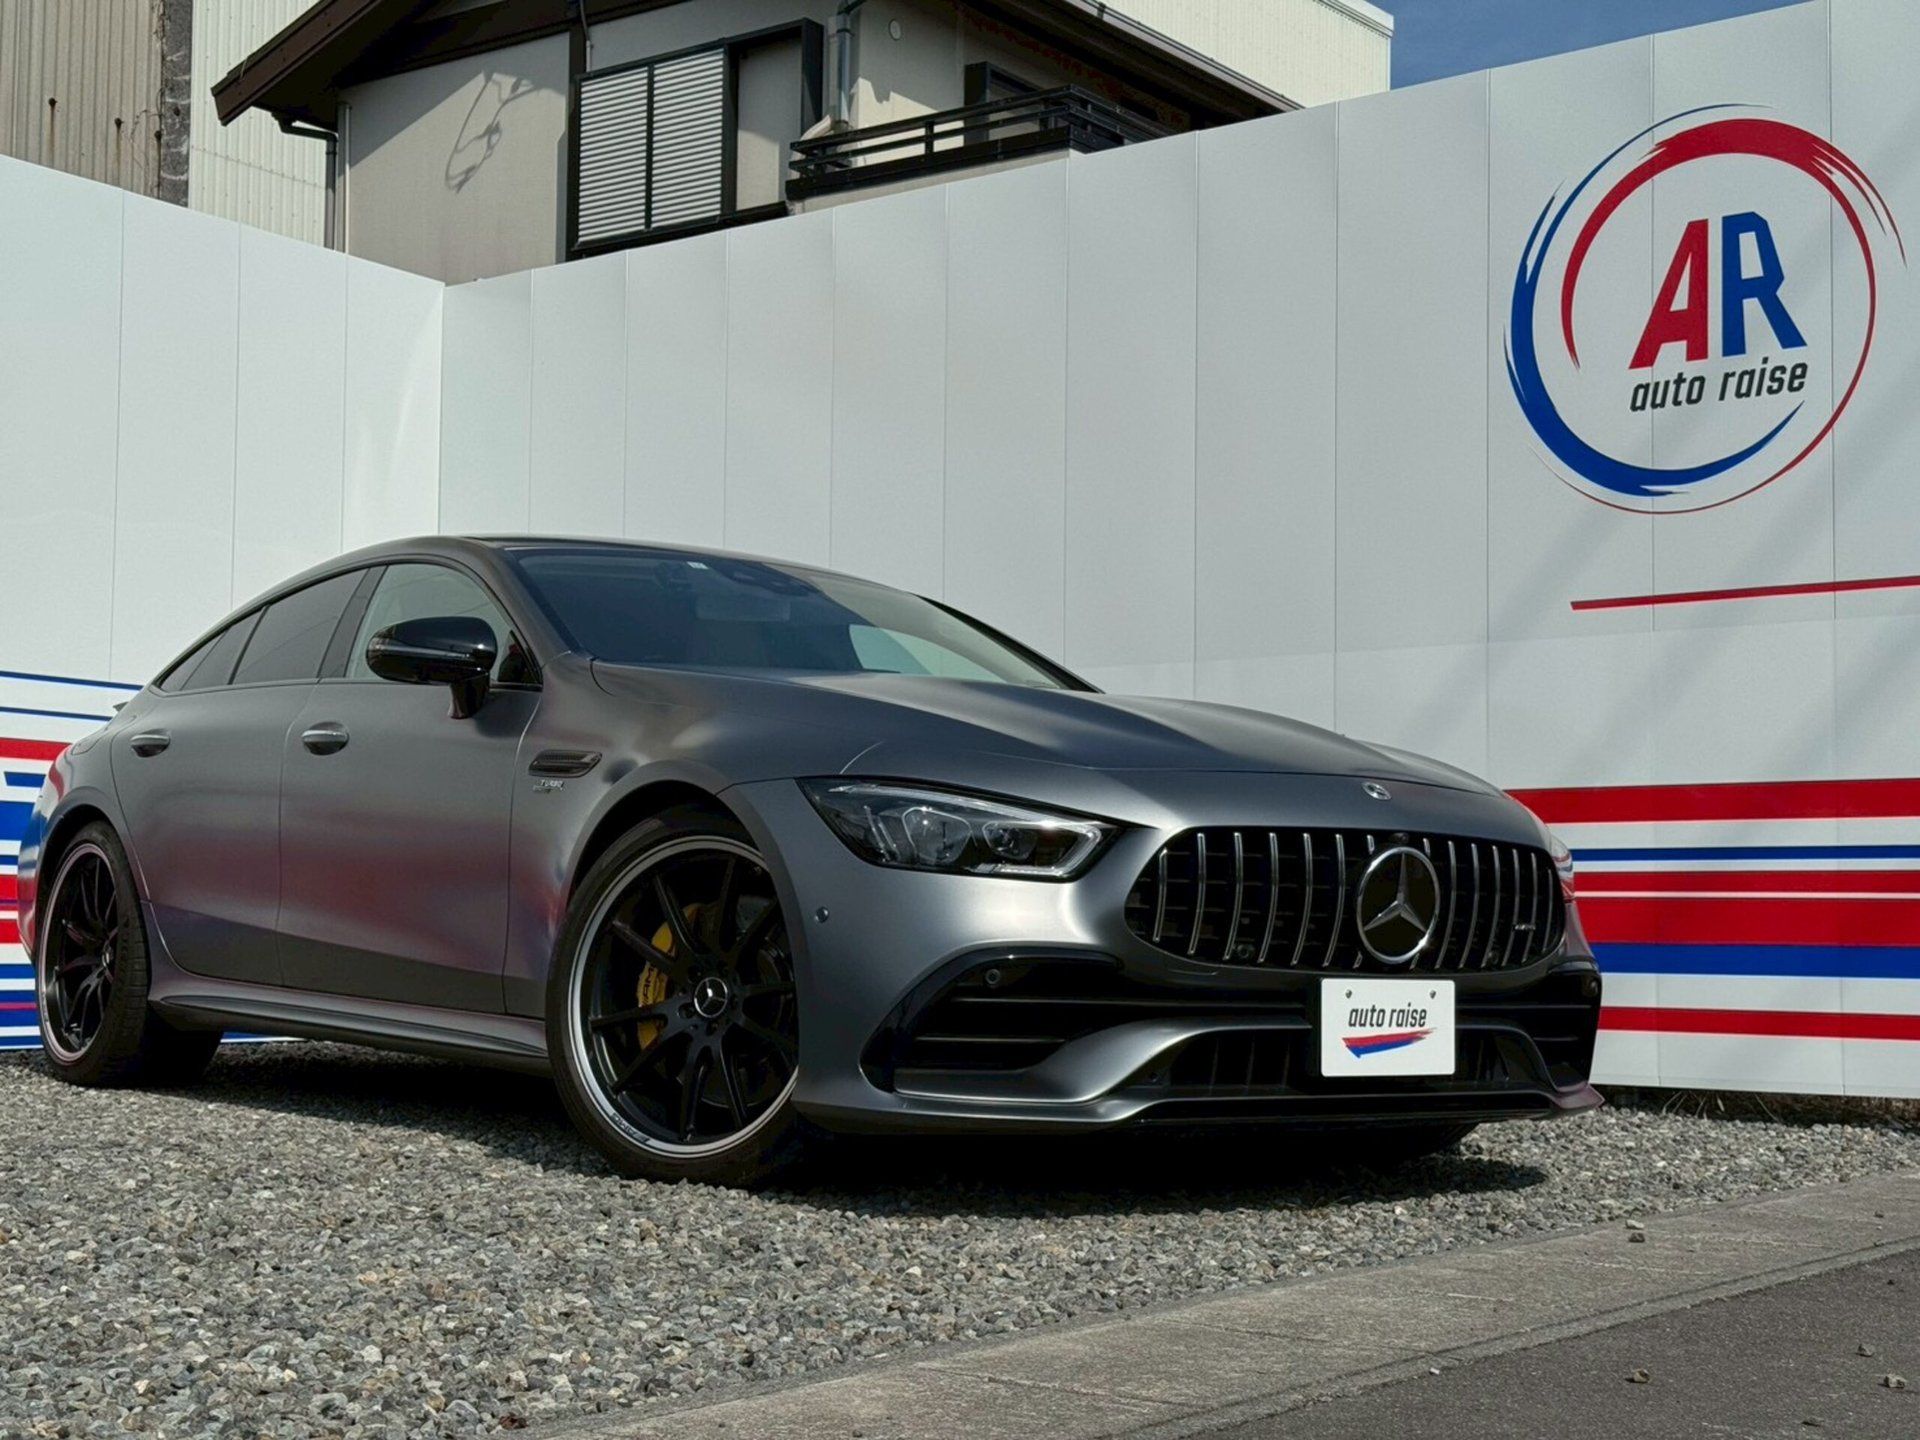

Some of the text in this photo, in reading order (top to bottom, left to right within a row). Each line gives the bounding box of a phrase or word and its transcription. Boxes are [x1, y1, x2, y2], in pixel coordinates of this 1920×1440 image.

[1628, 211, 1808, 369] AR
[1630, 356, 1808, 412] auto raise
[1348, 1002, 1427, 1028] auto raise
